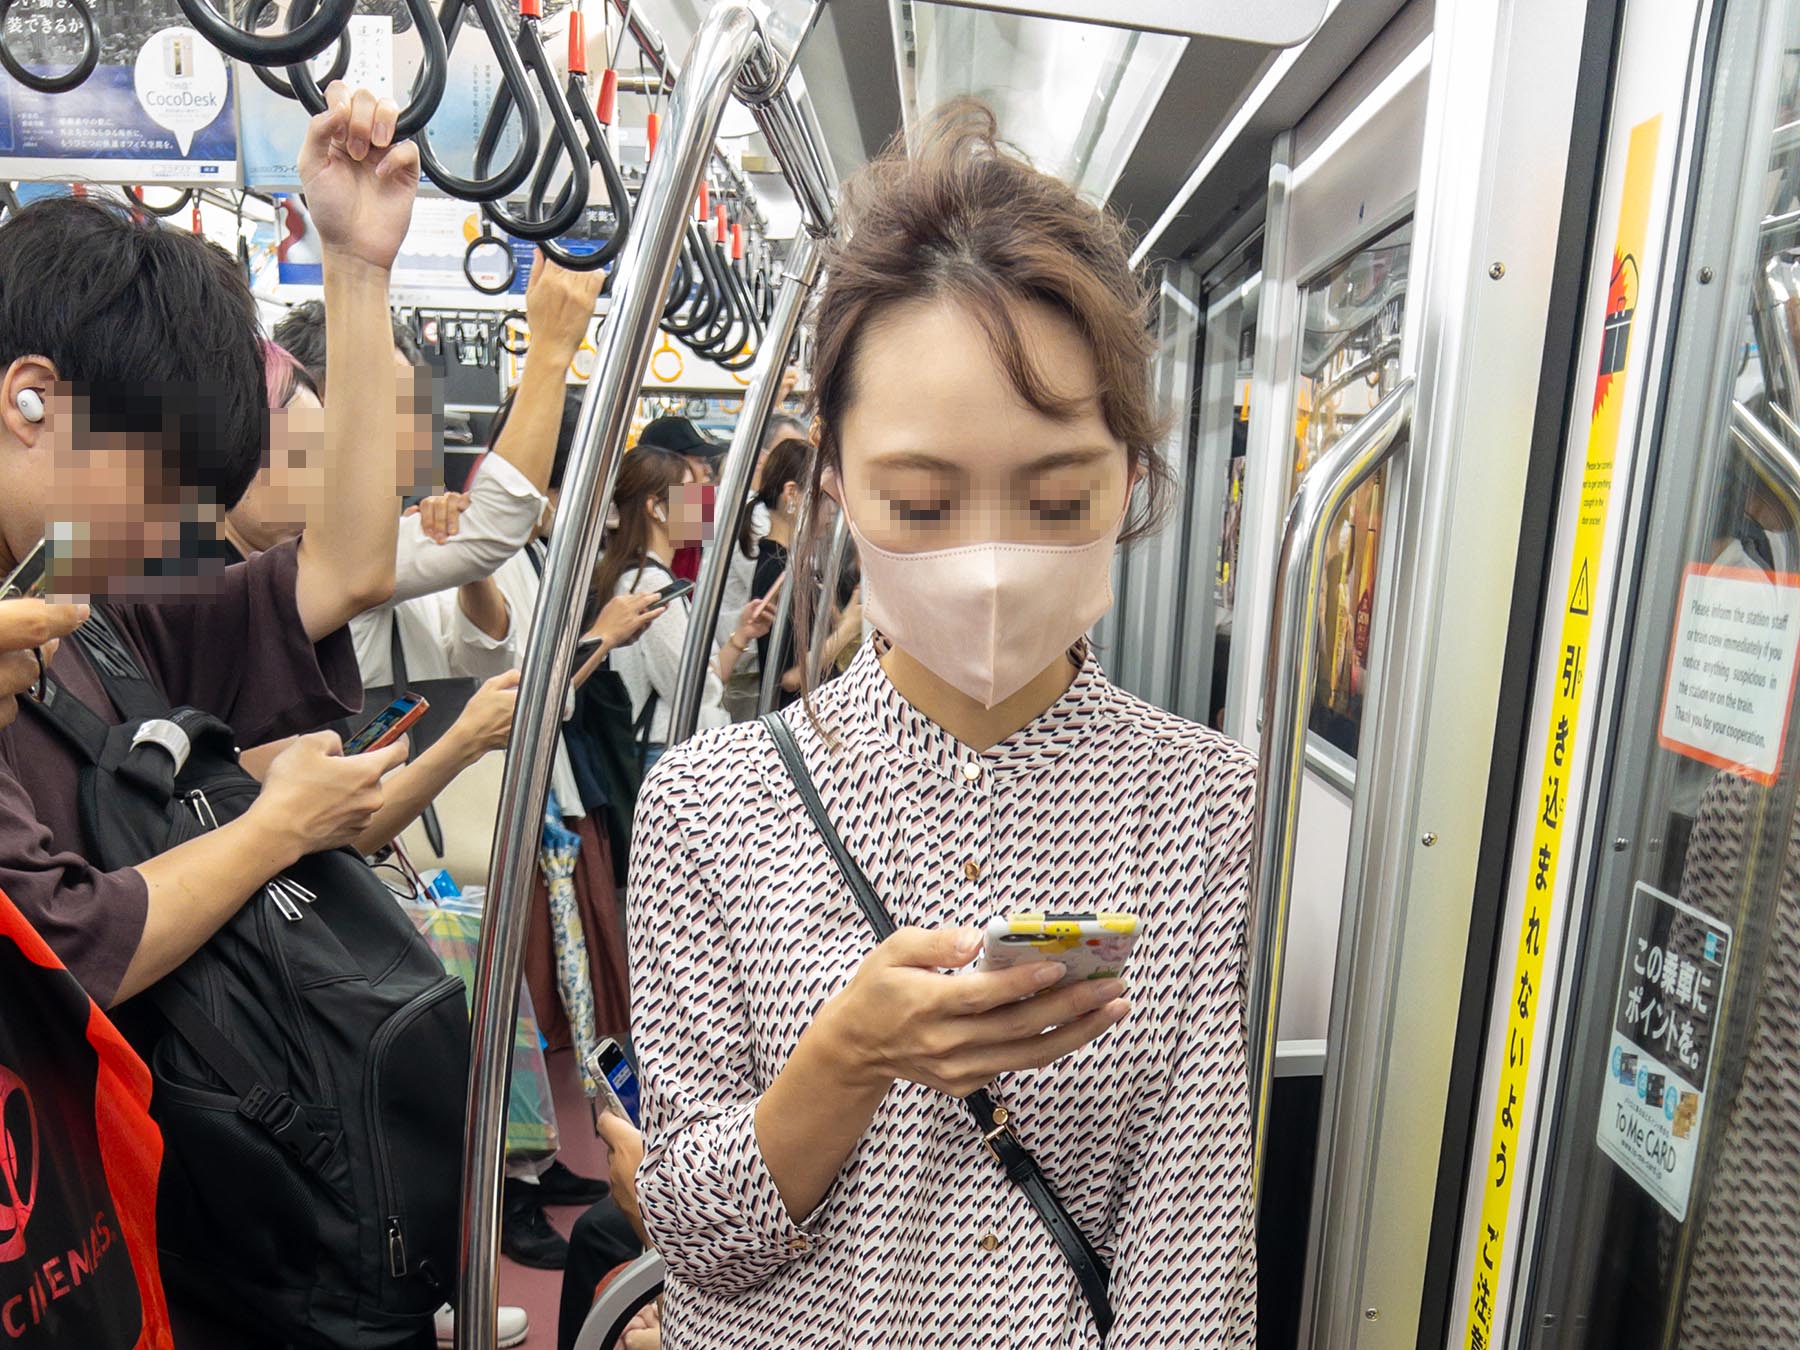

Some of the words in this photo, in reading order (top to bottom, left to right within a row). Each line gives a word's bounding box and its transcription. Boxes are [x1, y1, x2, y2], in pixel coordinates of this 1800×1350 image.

[146, 91, 218, 106] CocoDesk
[1691, 599, 1709, 617] Please
[1711, 602, 1732, 620] inform
[1734, 606, 1745, 624] the
[1746, 609, 1770, 628] station
[1772, 613, 1789, 631] staff
[1686, 629, 1693, 641] or
[1694, 629, 1708, 645] train
[1708, 633, 1722, 647] crew
[1722, 633, 1762, 660] immediately
[1763, 640, 1770, 658] if
[1768, 646, 1783, 663] you
[1682, 656, 1700, 671] notice
[1703, 660, 1731, 682] anything
[1733, 667, 1767, 688] suspicious
[1769, 672, 1777, 690] in
[1679, 681, 1688, 696] the
[1688, 685, 1709, 700] station
[1709, 691, 1716, 703] or
[1716, 693, 1725, 706] on
[1726, 692, 1736, 710] the
[1737, 697, 1754, 714] train.
[1675, 705, 1690, 722] Thank
[1691, 713, 1701, 728] you
[1702, 713, 1712, 730] for
[1712, 720, 1727, 735] your
[1726, 724, 1765, 749] cooperation.
[1633, 937, 1712, 1014] この乗車に
[1625, 985, 1699, 1070] ポイントを。
[1615, 1102, 1626, 1134] To
[1626, 1113, 1645, 1149] Me
[1645, 1129, 1677, 1174] CARD
